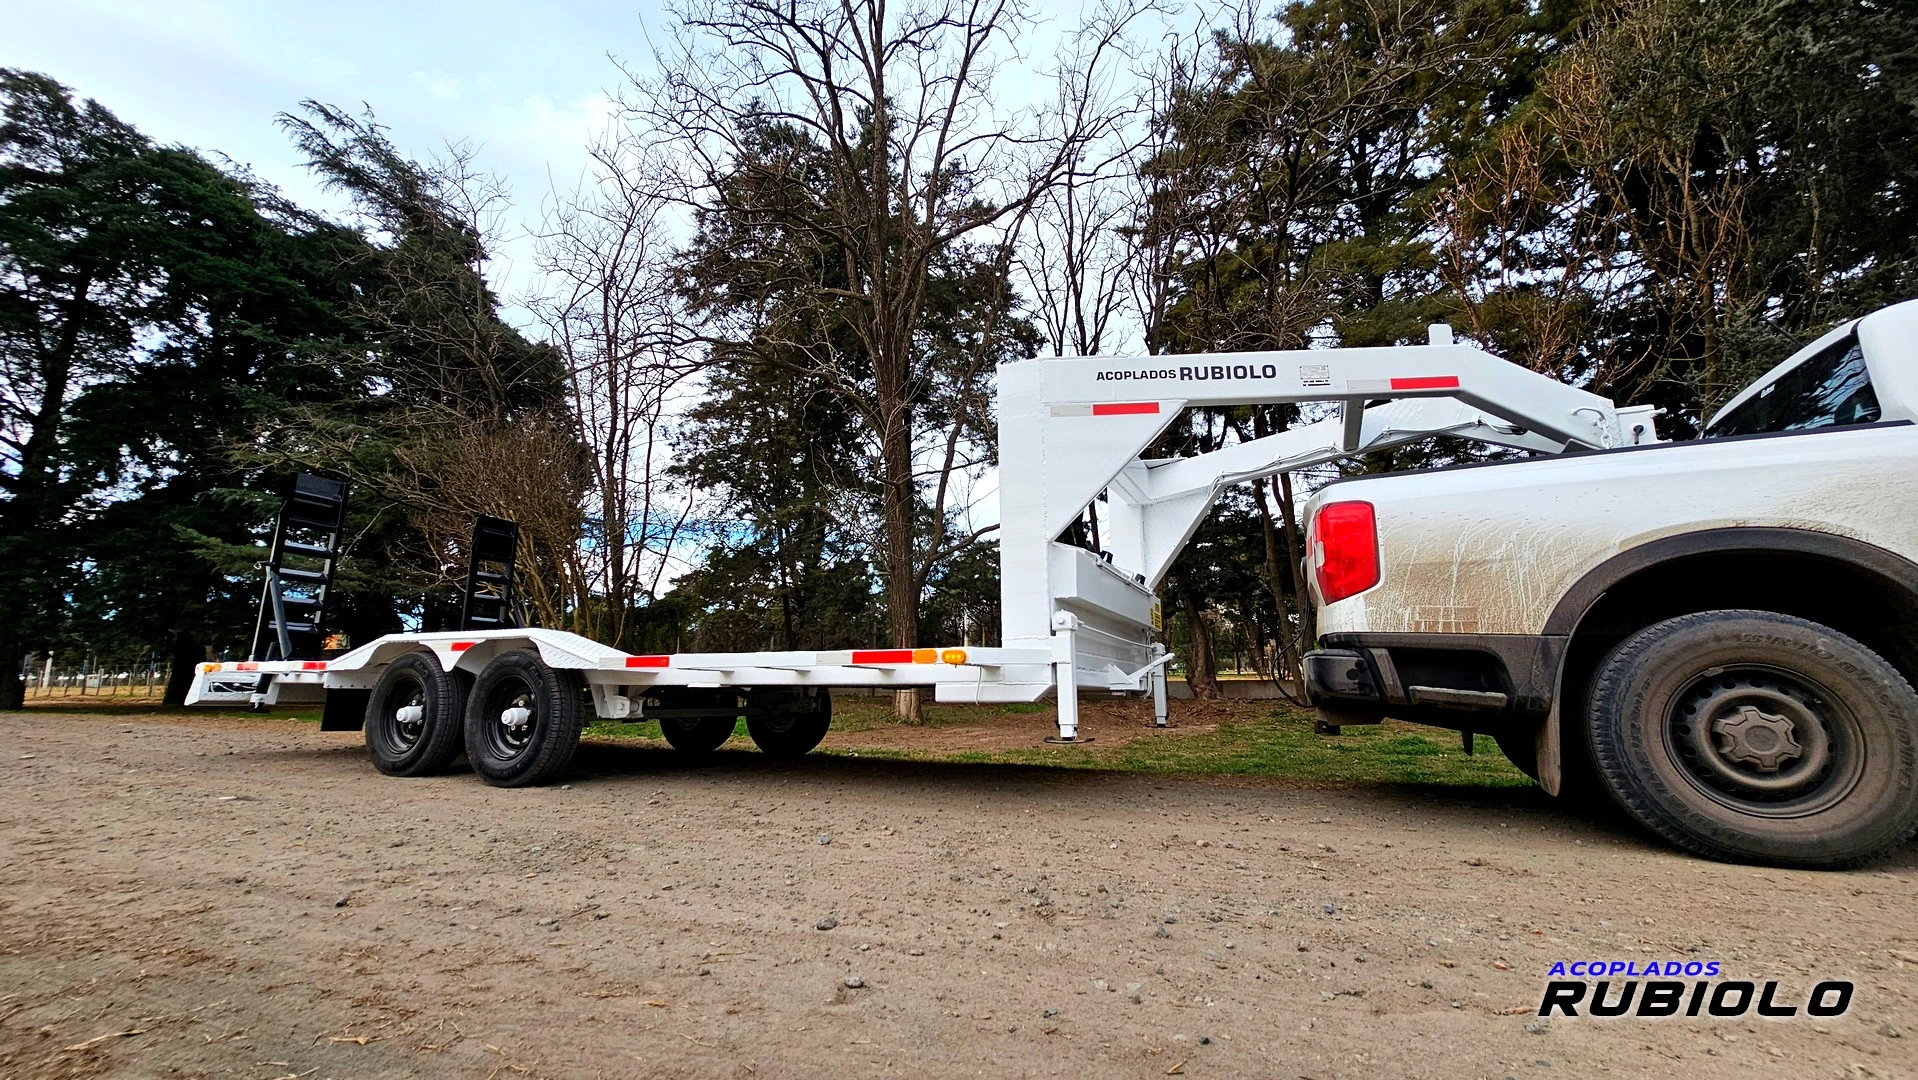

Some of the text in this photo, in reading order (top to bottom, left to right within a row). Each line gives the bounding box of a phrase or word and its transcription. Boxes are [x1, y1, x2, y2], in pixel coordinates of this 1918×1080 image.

[1096, 364, 1277, 381] ACOPLADOS RUBIOLO
[1737, 631, 1912, 787] BRIDGESTONE
